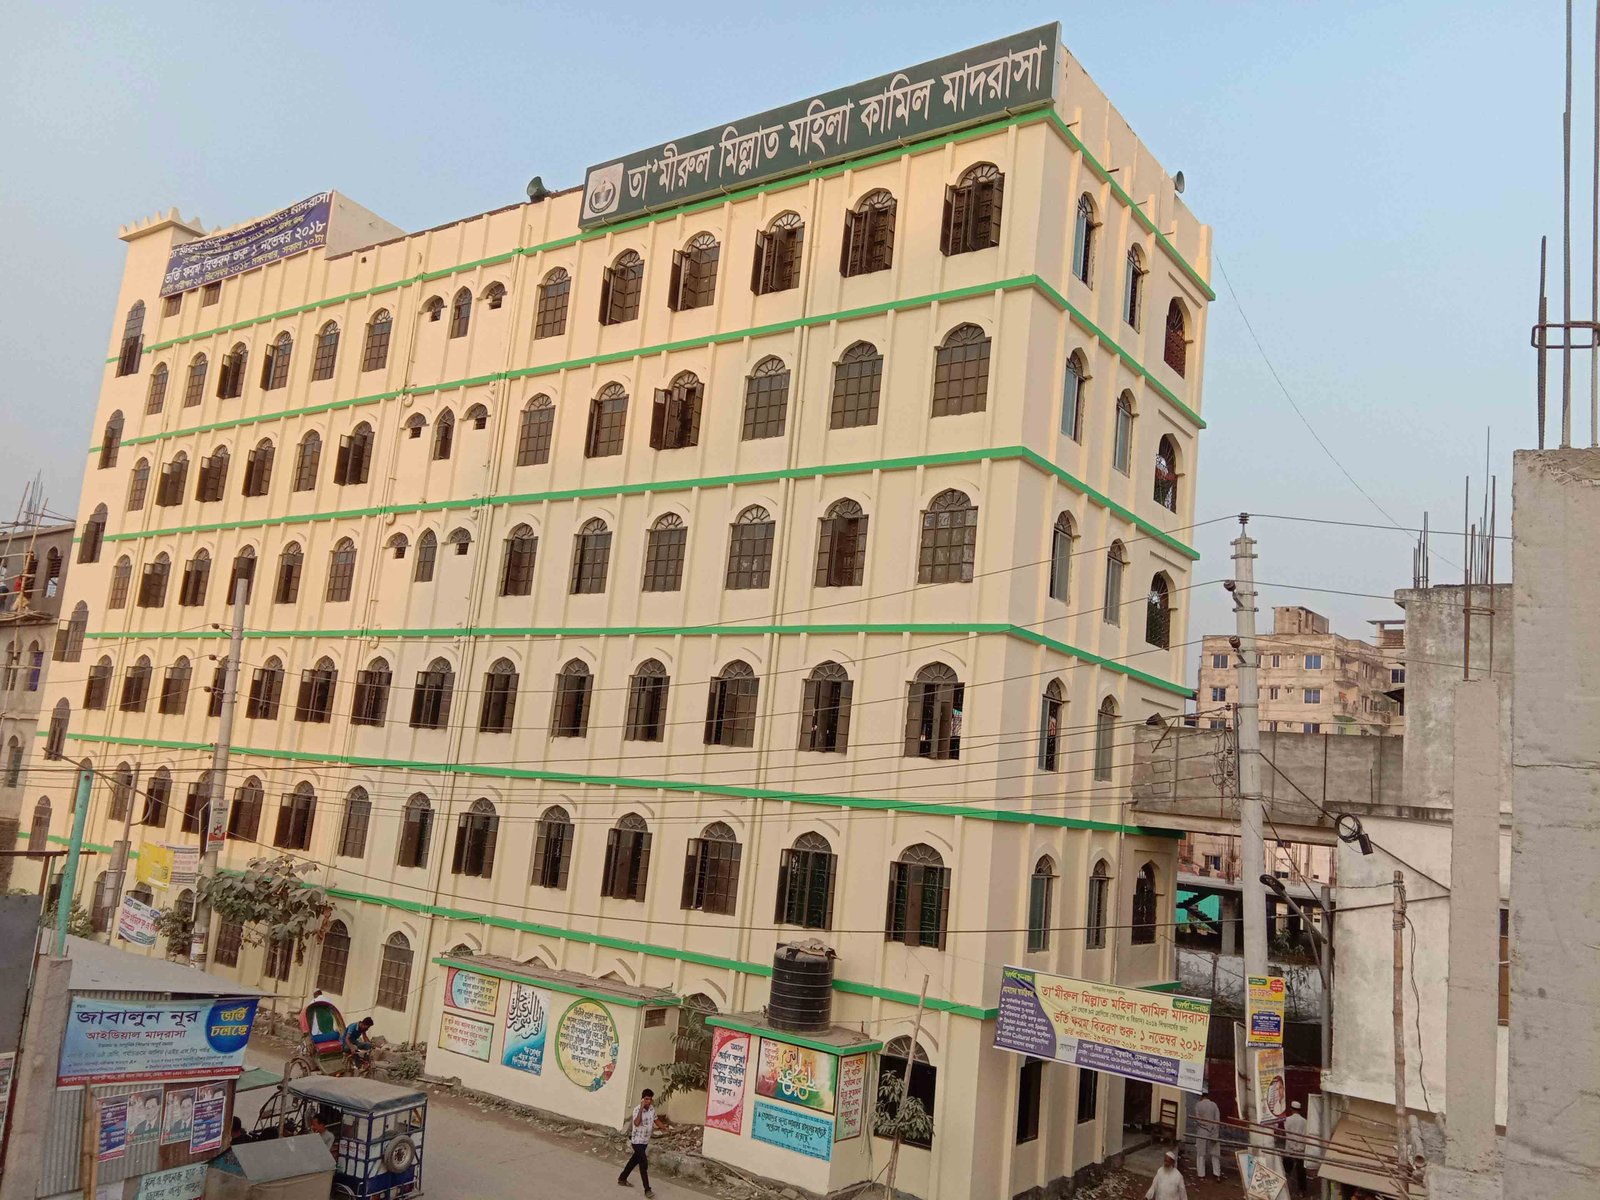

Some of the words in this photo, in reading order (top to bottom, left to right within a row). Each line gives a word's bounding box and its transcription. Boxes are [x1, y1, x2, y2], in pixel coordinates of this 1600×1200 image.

[718, 123, 784, 177] মিল্লাত
[789, 98, 854, 154] মহিলা
[859, 74, 936, 135] কামিল
[942, 40, 1047, 112] মাদরাসা
[295, 221, 326, 239] ২০১৮
[304, 234, 324, 247] ১০টা
[219, 1006, 249, 1022] ভর্তি
[1081, 990, 1108, 1008] মিল্লাত
[1112, 997, 1137, 1014] মহিলা
[1141, 1001, 1168, 1019] কামিল
[1172, 1009, 1209, 1024] মাদরাসা
[76, 1009, 164, 1027] জাবালুন
[170, 1010, 201, 1027] নূর
[85, 1029, 140, 1040] আইডিয়াল
[210, 1024, 249, 1037] চলছে
[1012, 1033, 1030, 1041] Cultural
[1054, 1011, 1069, 1024] ভর্তি
[1071, 1016, 1089, 1030] ফরম
[1092, 1017, 1117, 1034] বিতরণ
[1139, 1030, 1145, 1041] ১
[1149, 1031, 1177, 1046] নভেম্বর
[1179, 1038, 1205, 1051] ২০১৮
[732, 1054, 745, 1064] করা
